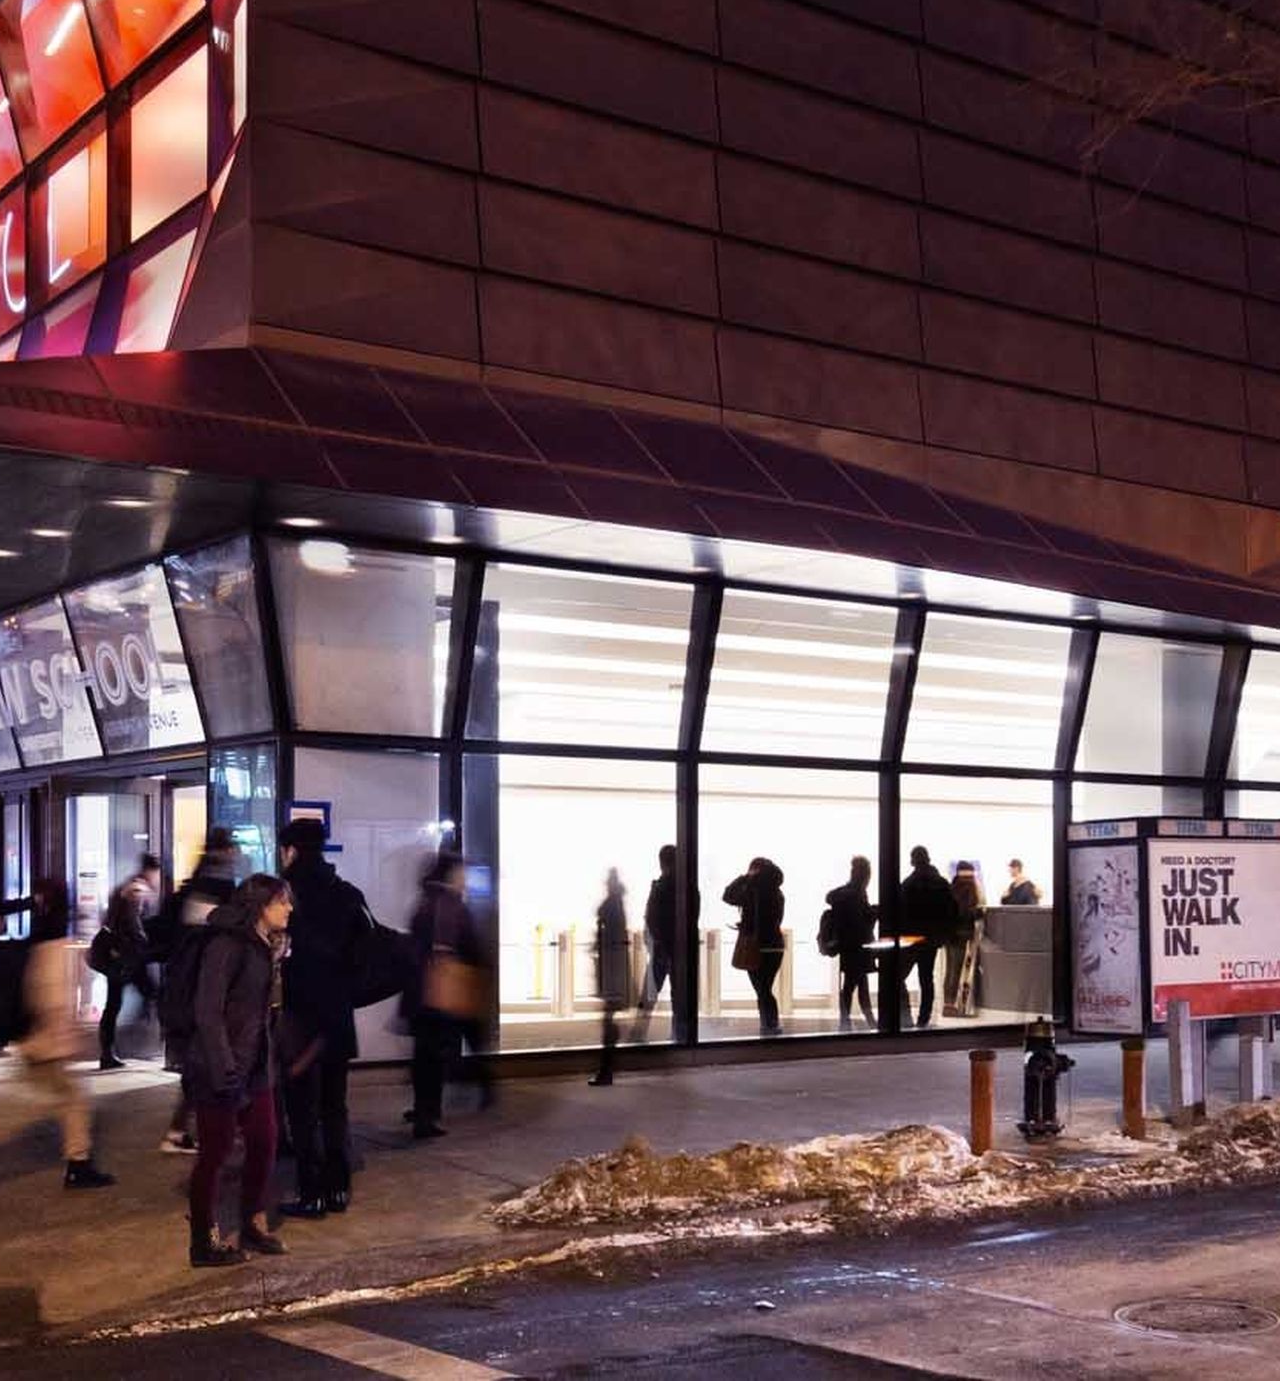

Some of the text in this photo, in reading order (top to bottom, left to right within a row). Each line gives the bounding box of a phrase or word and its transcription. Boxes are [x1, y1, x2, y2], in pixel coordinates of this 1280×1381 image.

[29, 626, 181, 720] SCHOOL
[1186, 857, 1193, 865] A
[1162, 868, 1235, 897] JUST
[1162, 897, 1241, 926] WALK
[1164, 927, 1199, 956] IN.
